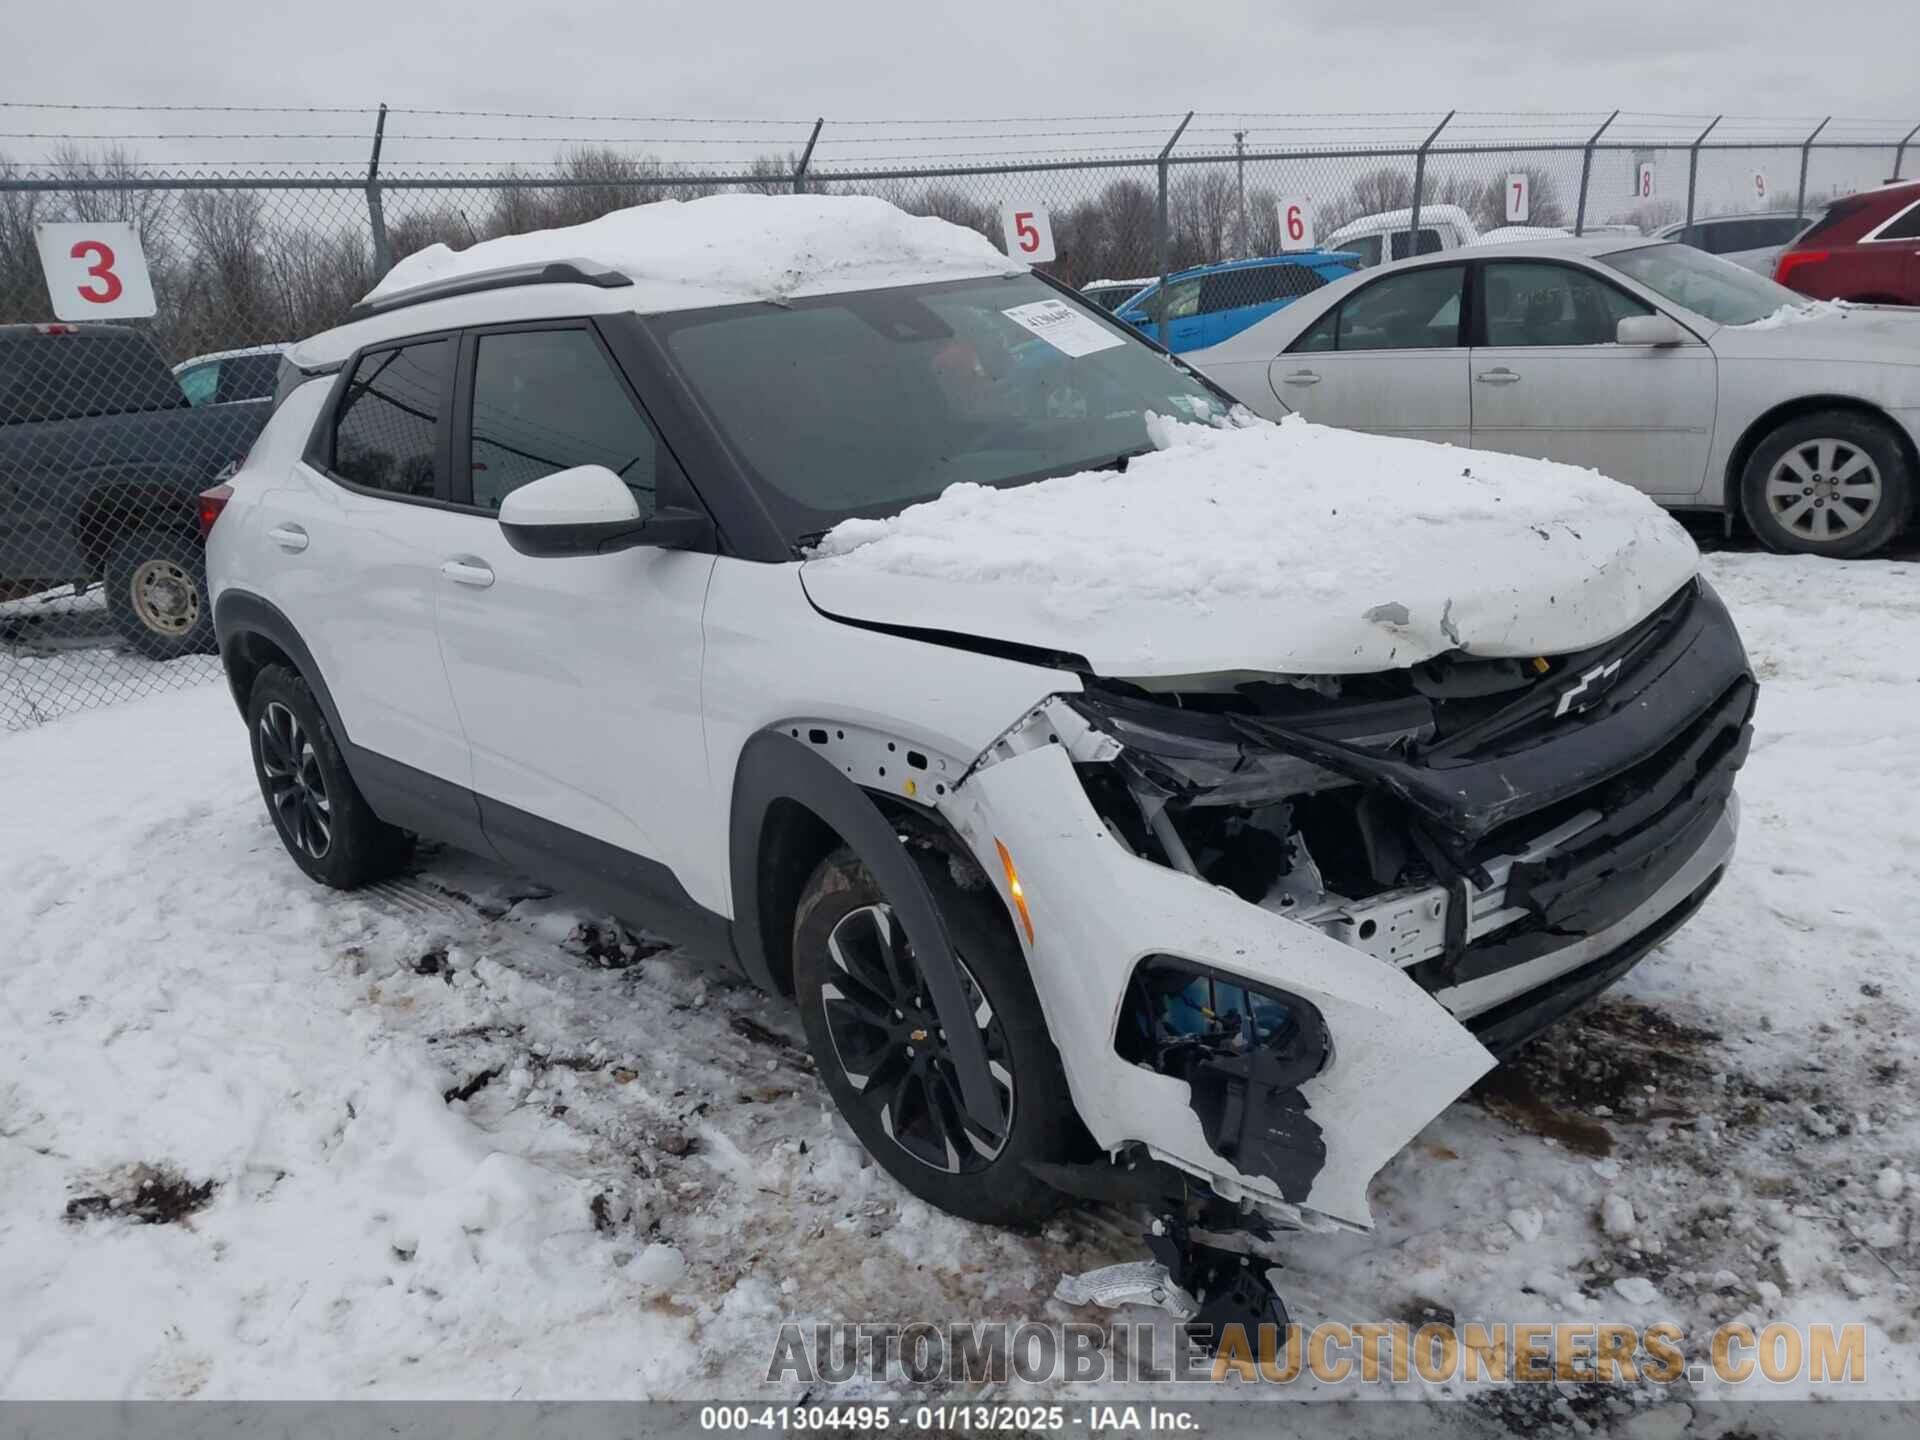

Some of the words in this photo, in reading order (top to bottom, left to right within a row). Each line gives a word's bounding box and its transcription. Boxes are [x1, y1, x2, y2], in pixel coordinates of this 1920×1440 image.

[1512, 182, 1522, 213] 7
[1643, 171, 1650, 198] 8
[1755, 174, 1764, 198] 9
[1014, 211, 1040, 253] 5
[1287, 205, 1304, 241] 6
[70, 240, 123, 304] 3
